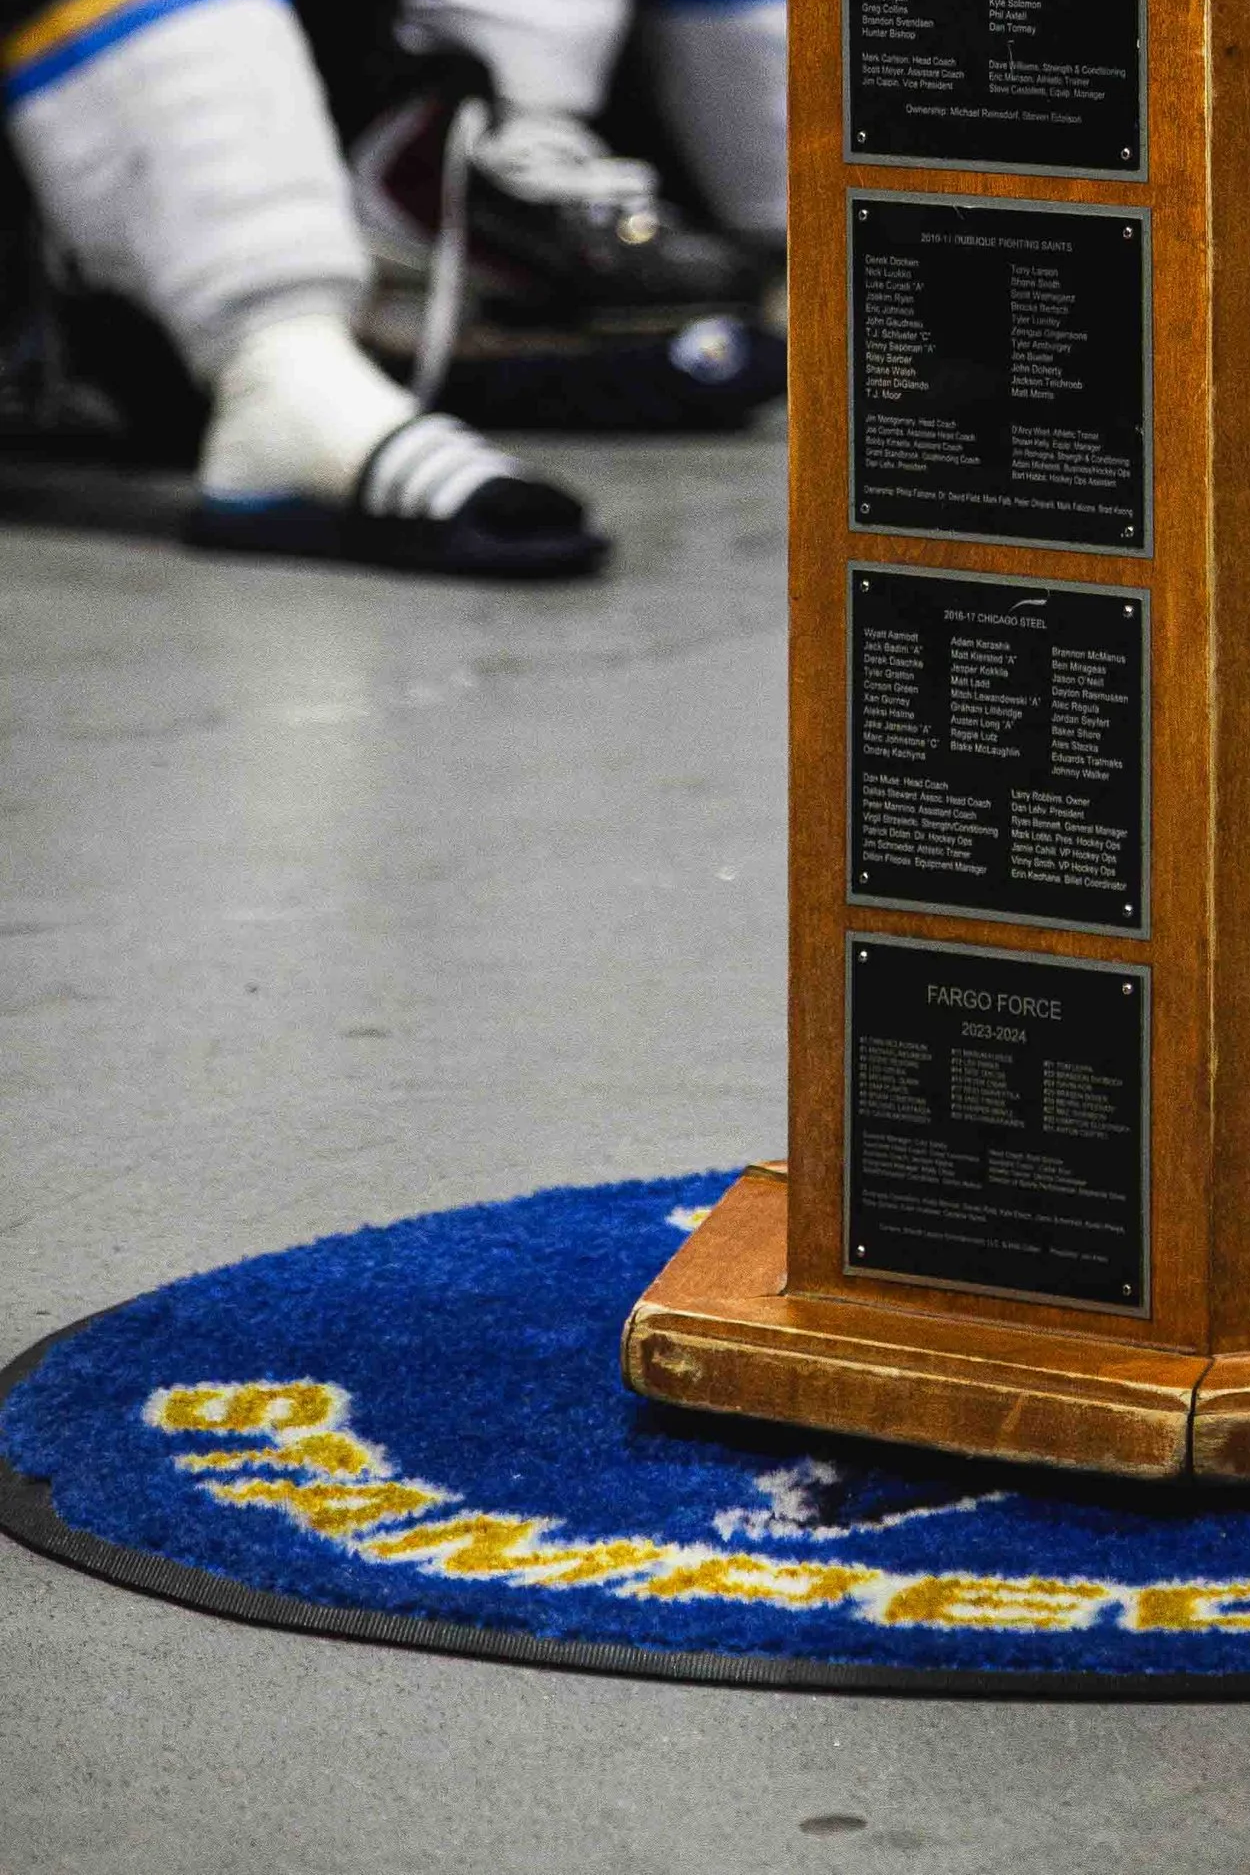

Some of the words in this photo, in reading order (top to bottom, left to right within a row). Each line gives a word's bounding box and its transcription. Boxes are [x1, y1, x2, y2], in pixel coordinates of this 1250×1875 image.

[944, 609, 975, 621] 2016-17
[977, 613, 1018, 625] CHICAGO
[1019, 617, 1046, 628] STEEL
[927, 984, 991, 1010] FARGO
[997, 993, 1062, 1019] FORCE
[961, 1021, 1026, 1043] 2023-2024
